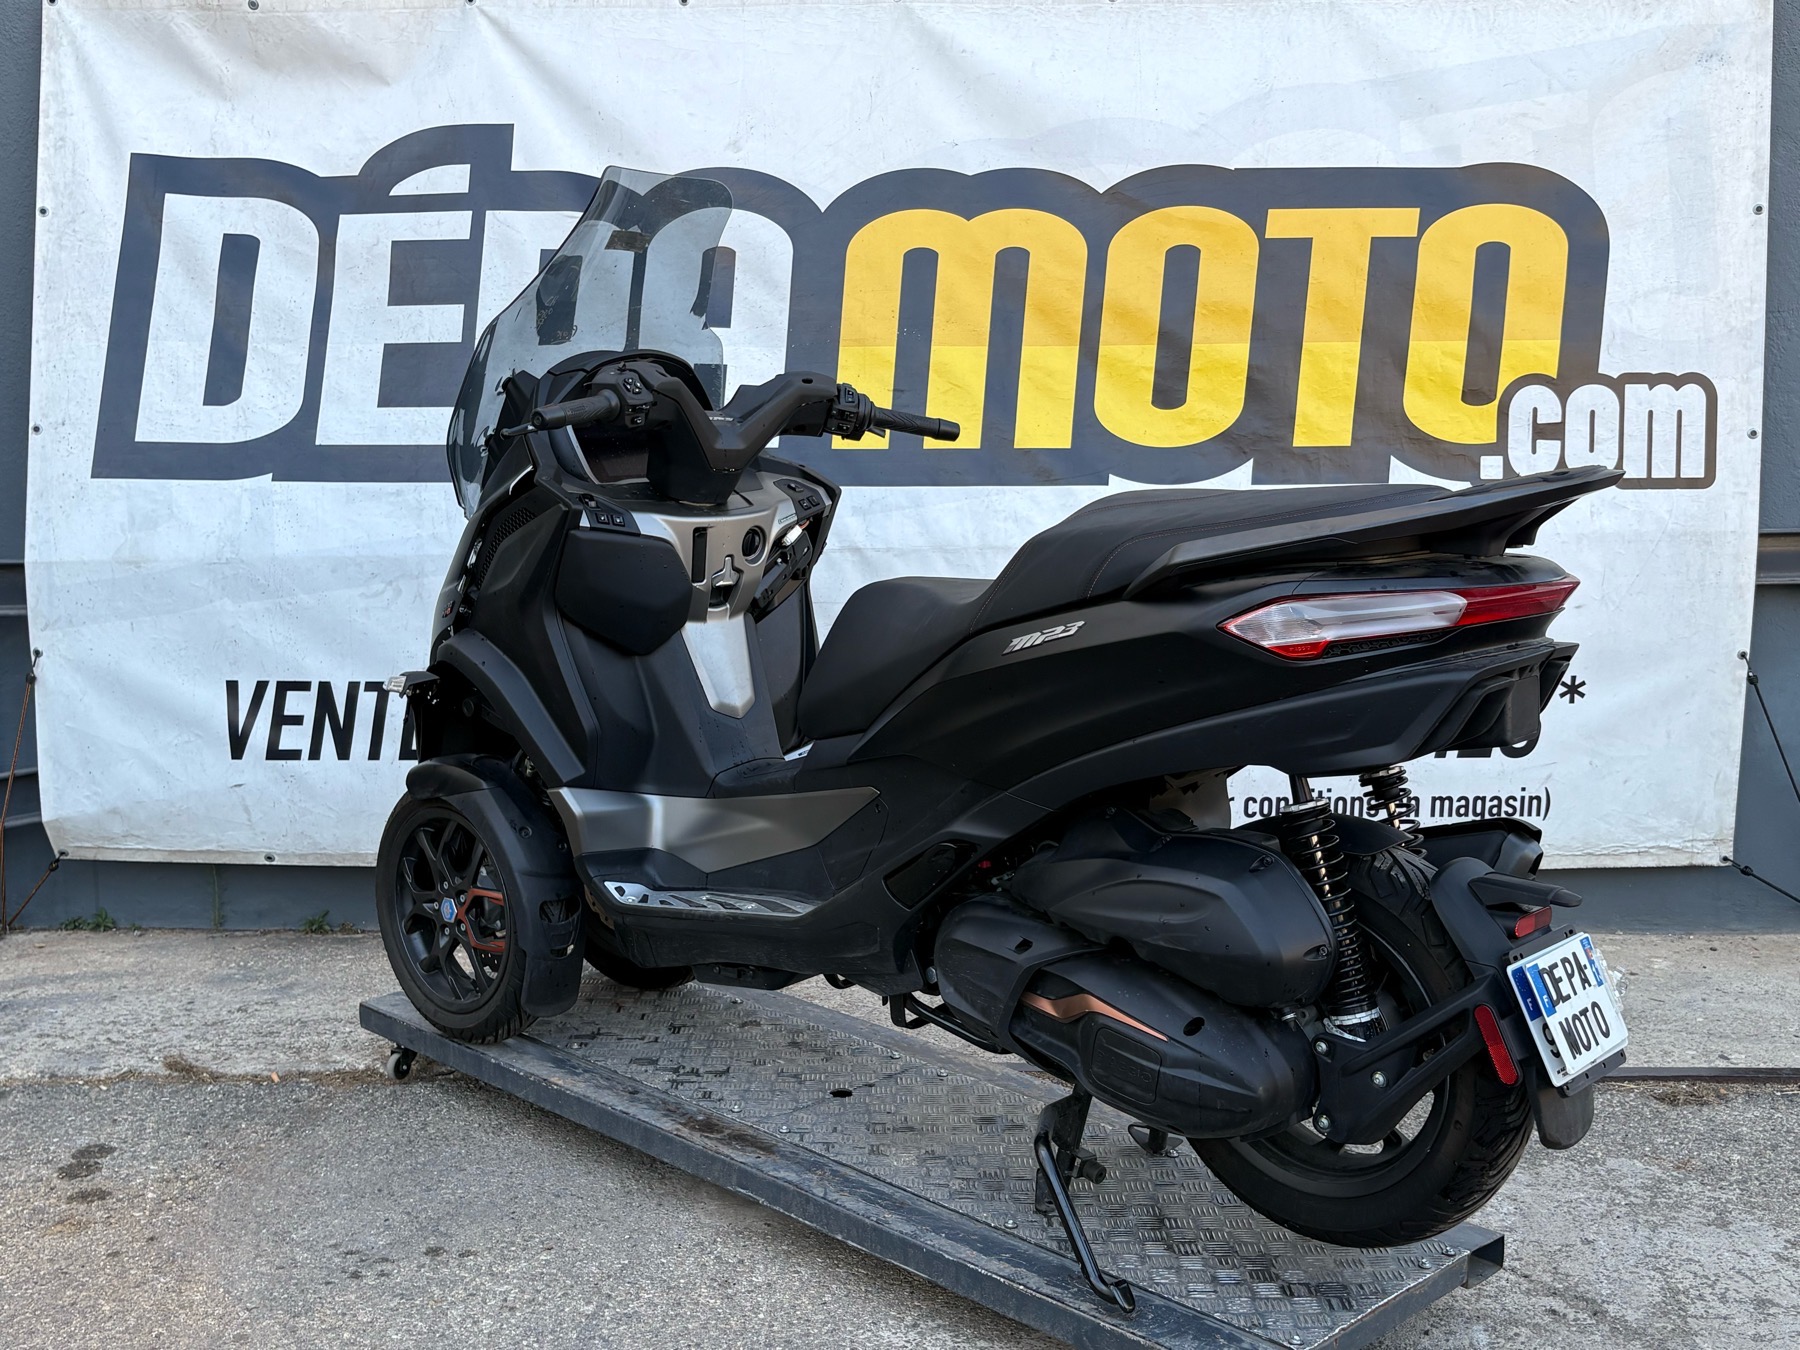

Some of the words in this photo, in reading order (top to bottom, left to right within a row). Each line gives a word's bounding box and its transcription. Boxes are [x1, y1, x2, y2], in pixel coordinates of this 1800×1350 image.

[1002, 620, 1085, 655] MP3
[1243, 787, 1380, 818] conions
[1430, 786, 1551, 821] magasin)
[1558, 1001, 1610, 1060] MOTO
